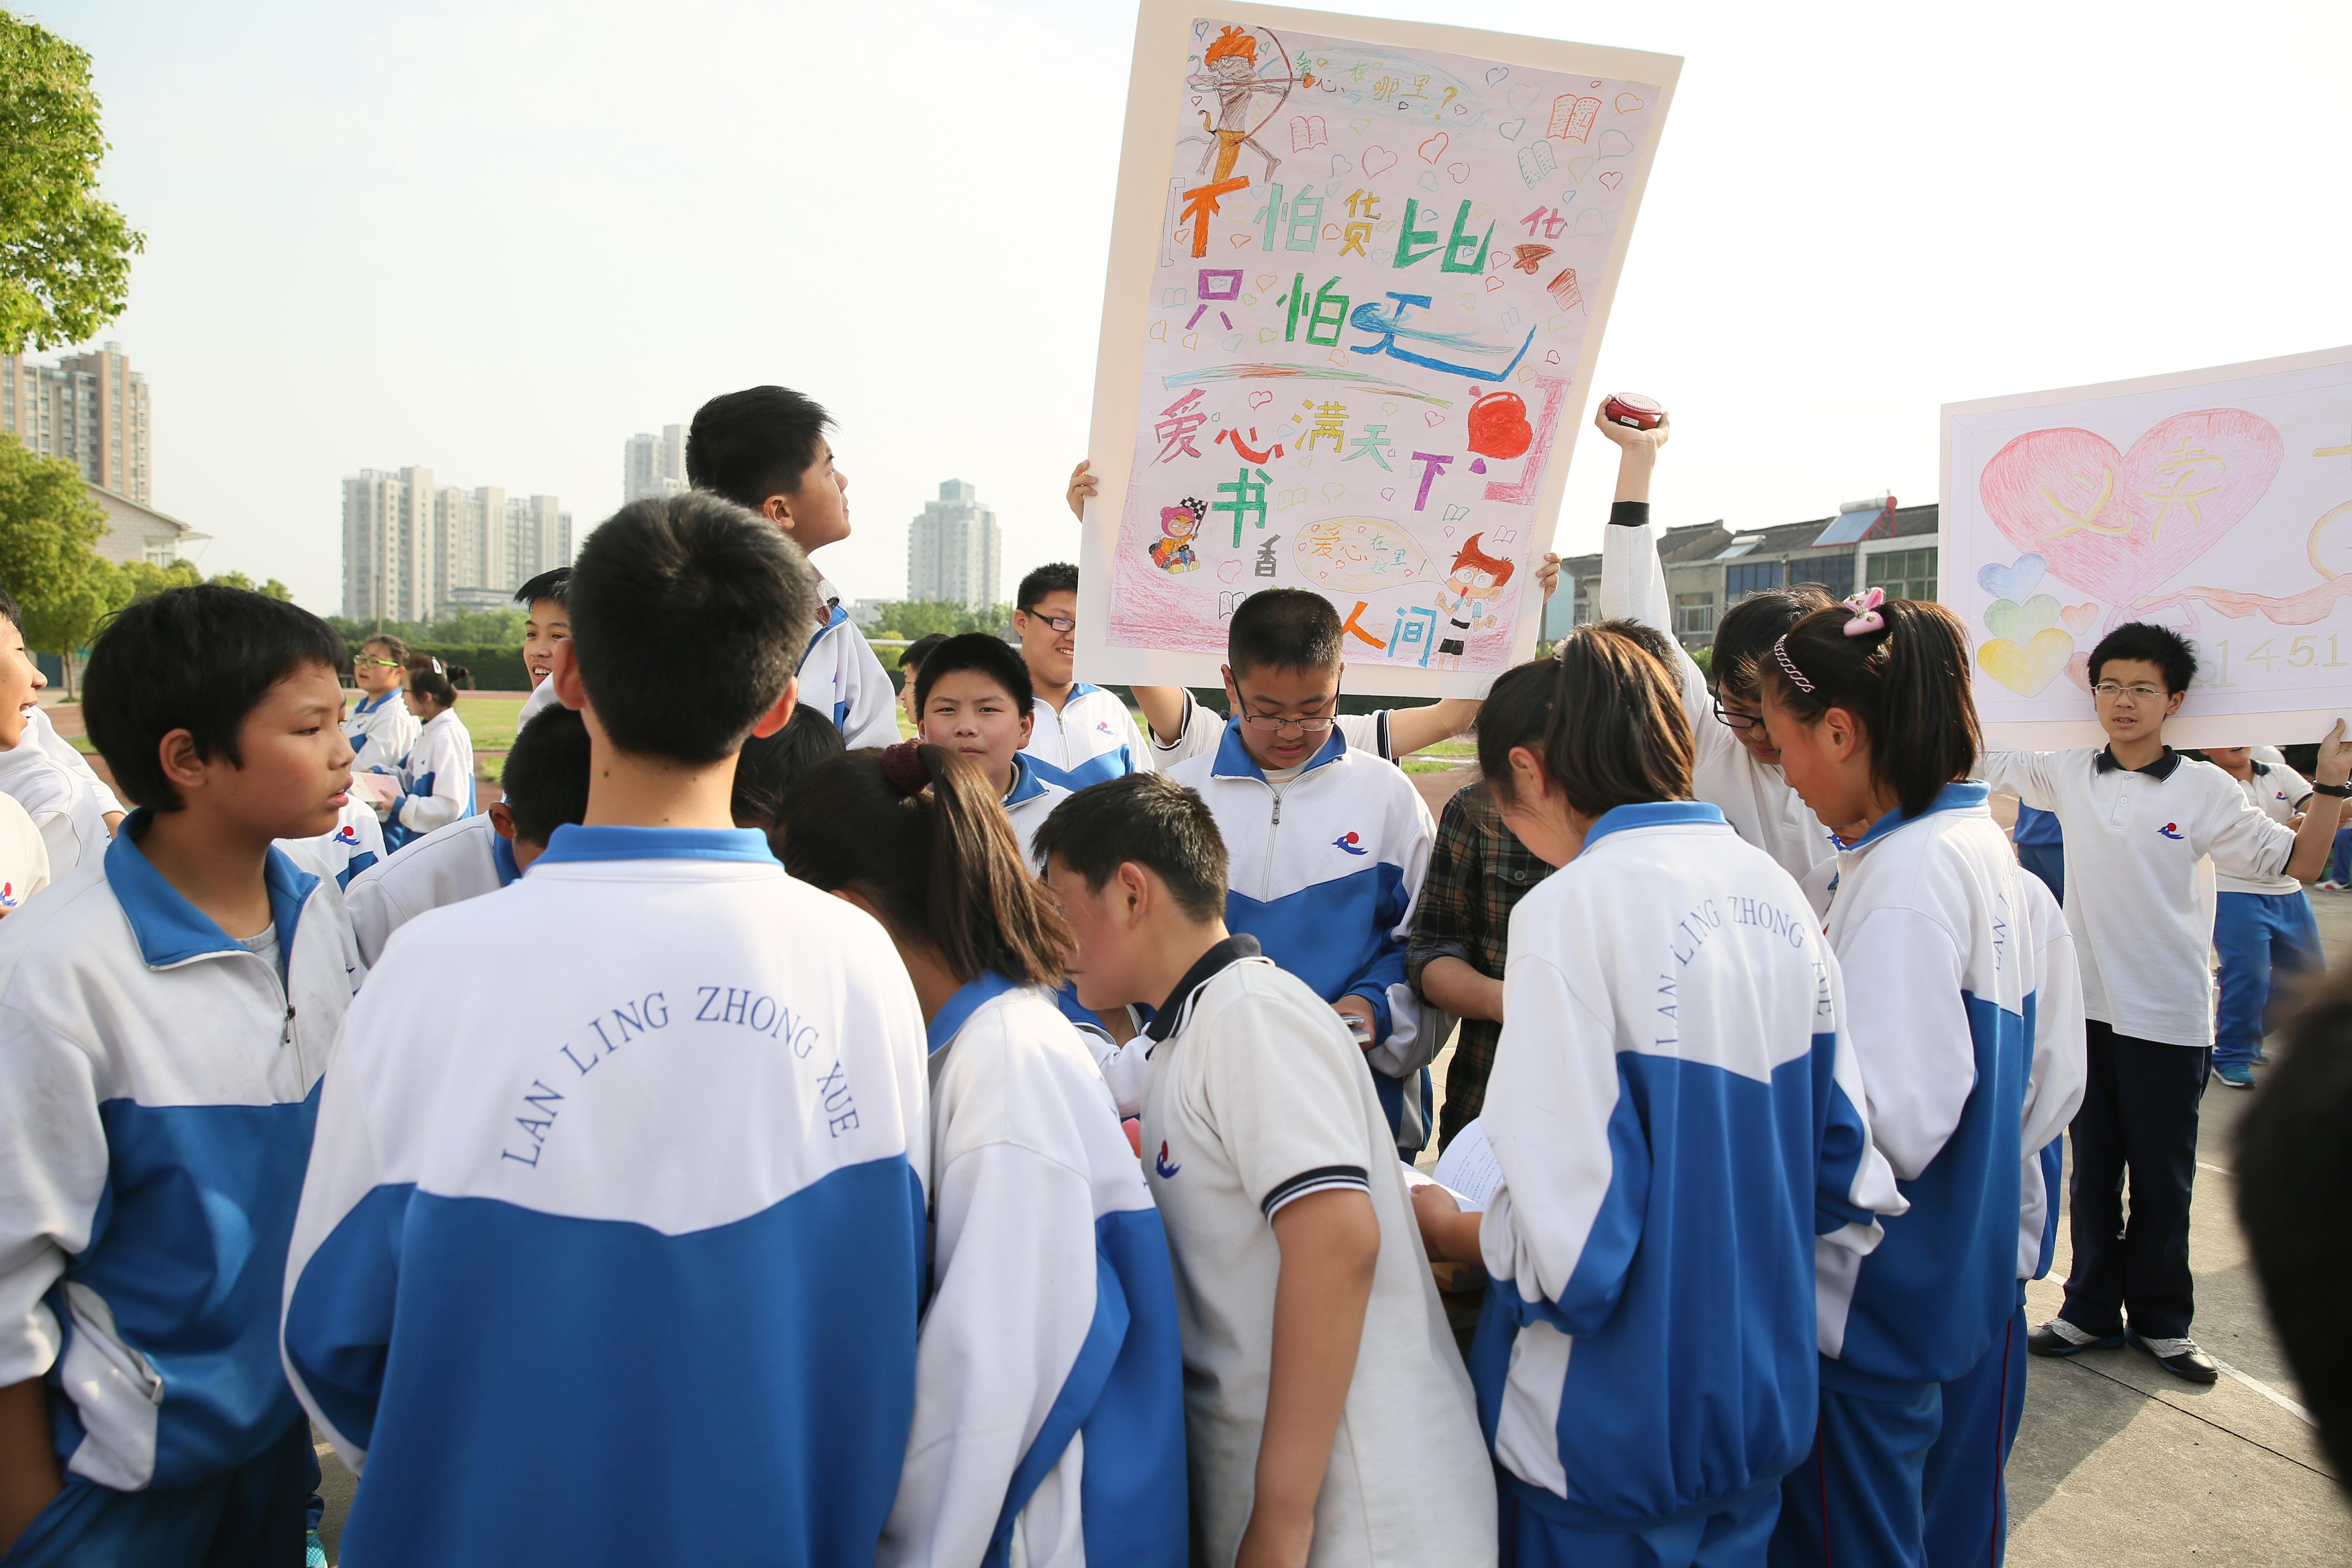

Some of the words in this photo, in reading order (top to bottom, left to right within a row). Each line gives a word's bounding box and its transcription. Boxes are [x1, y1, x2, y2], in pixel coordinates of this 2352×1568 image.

[2035, 436, 2227, 544] 义卖
[1670, 899, 1720, 966] LING
[1727, 896, 1805, 948] ZHONG
[502, 1079, 566, 1169] LAN
[560, 992, 670, 1075] LING
[695, 986, 819, 1060] ZHONG
[817, 1060, 860, 1139] XUE
